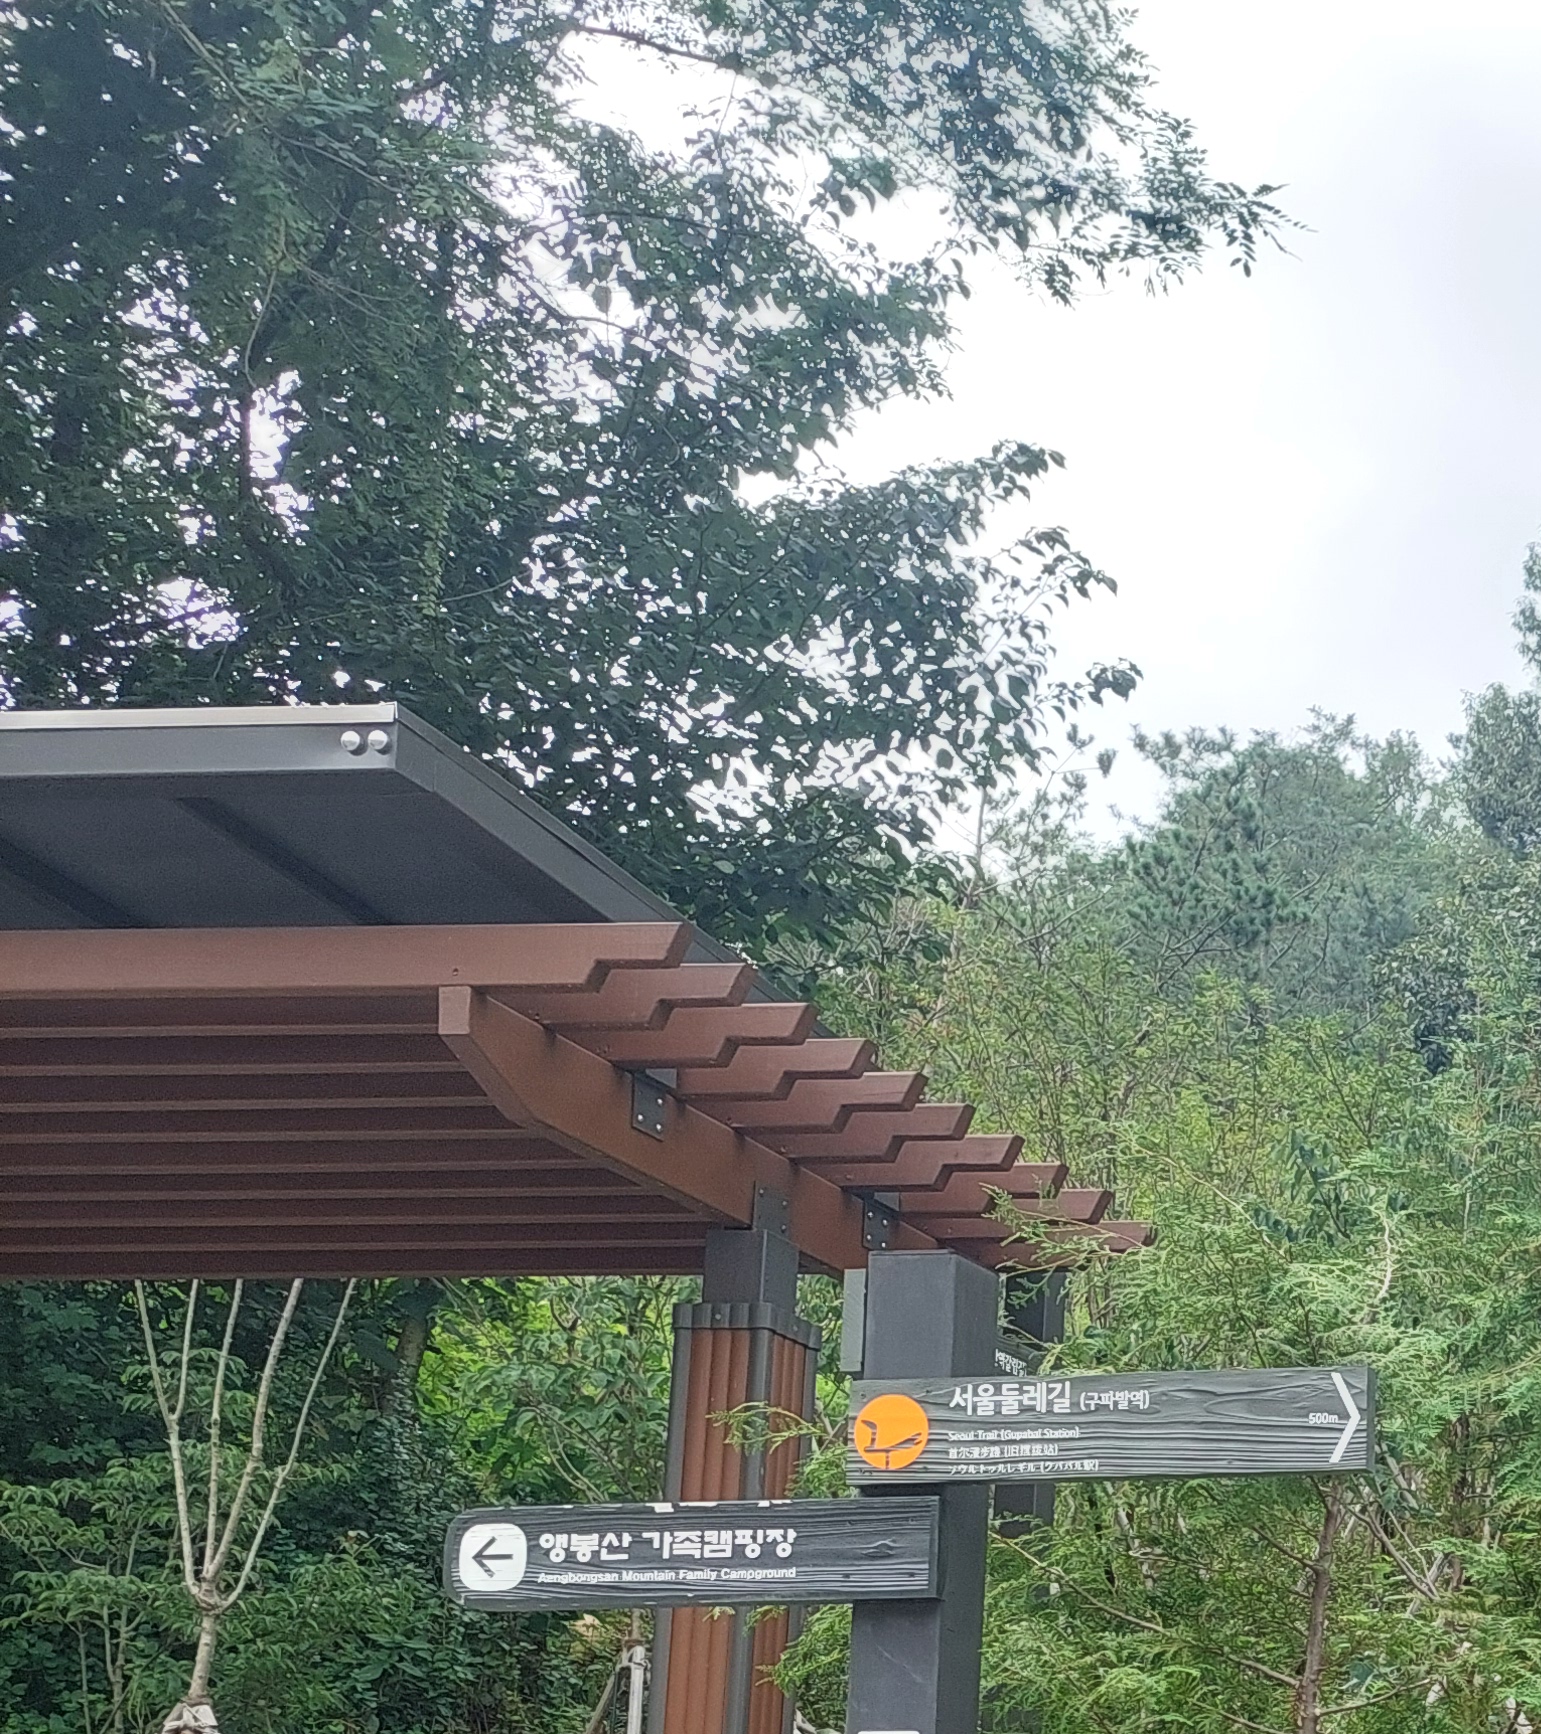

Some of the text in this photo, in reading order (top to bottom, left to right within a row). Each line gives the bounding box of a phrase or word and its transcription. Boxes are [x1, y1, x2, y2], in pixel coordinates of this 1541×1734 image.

[949, 1381, 1150, 1415] 서울둘레길 (구파발역)
[1308, 1412, 1339, 1425] 500m
[948, 1430, 975, 1441] Seoul
[976, 1429, 1000, 1440] Trail
[539, 1528, 797, 1563] 앵봉산 가족캠핑장
[538, 1567, 797, 1585] Aengbongsan Mountain Family Campground
